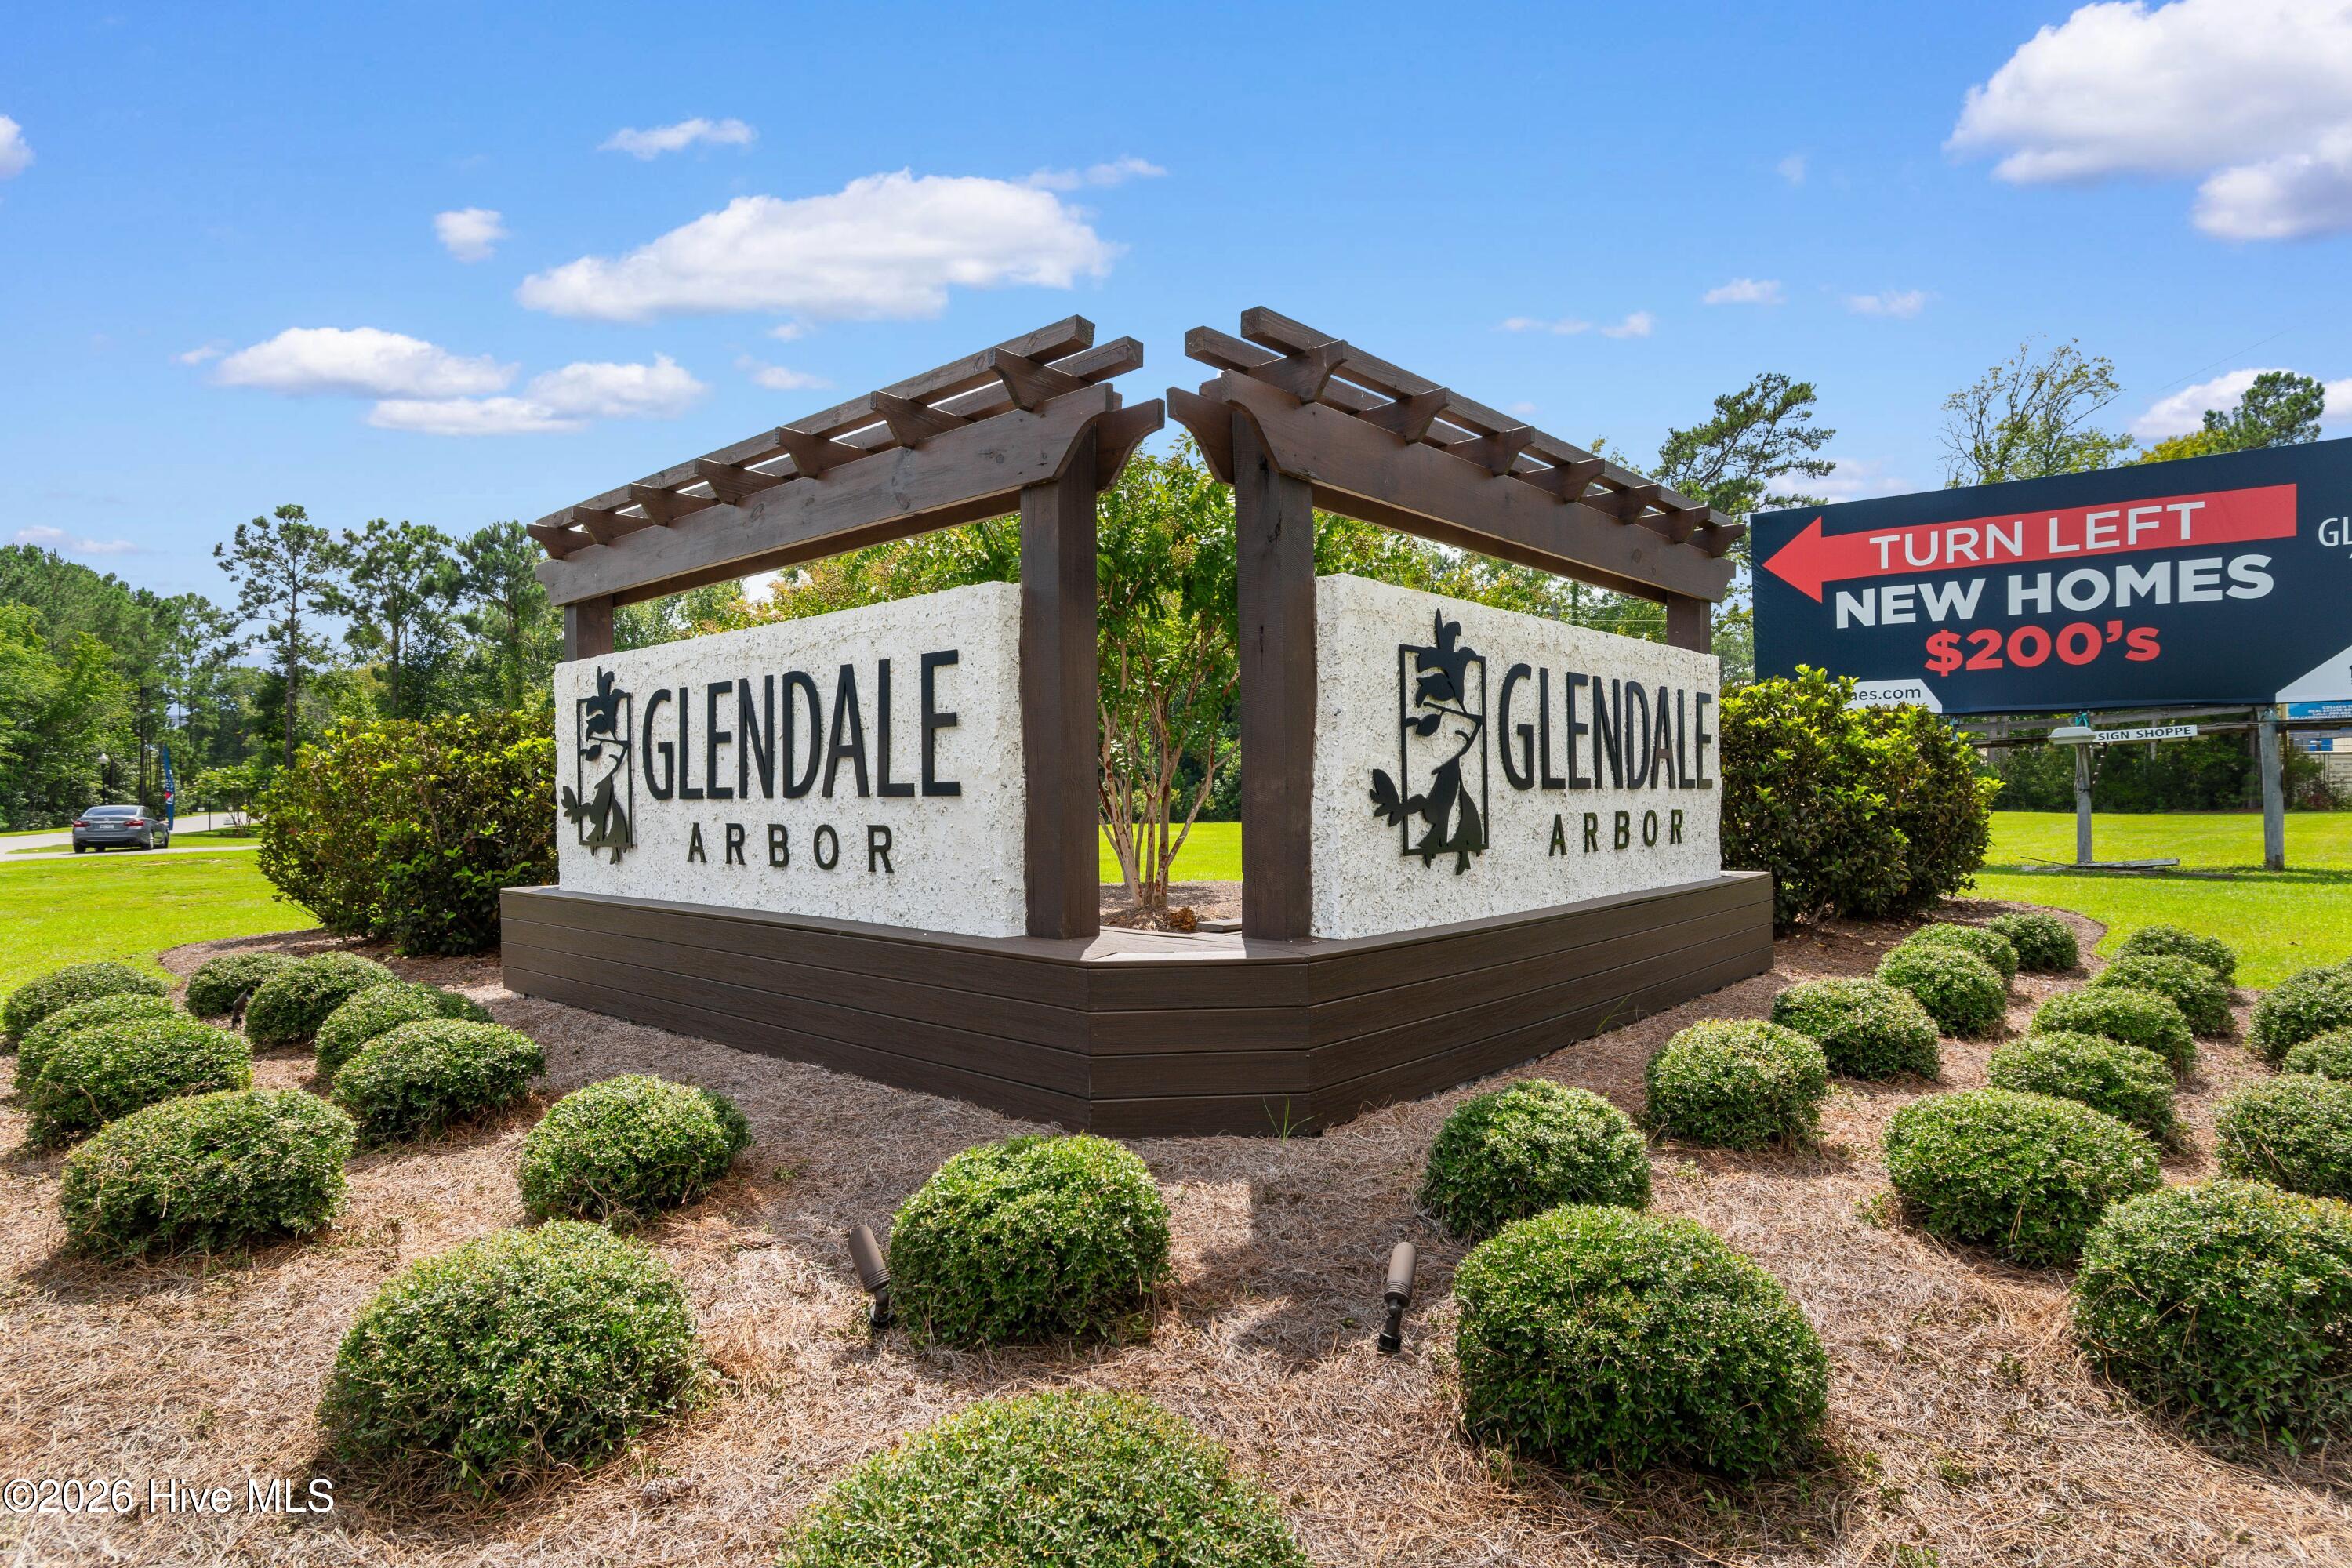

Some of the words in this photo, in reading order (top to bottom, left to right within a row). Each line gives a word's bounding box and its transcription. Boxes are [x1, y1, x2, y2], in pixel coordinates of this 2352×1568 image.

[1869, 521, 2023, 569] TURN
[2049, 501, 2205, 554] LEFT
[1835, 578, 1986, 629] NEW
[2008, 554, 2274, 615] HOMES
[641, 648, 961, 801] GLENDALE
[1499, 662, 1713, 791] GLENDALE
[2098, 731, 2129, 741] SIGN
[2136, 726, 2192, 739] SHOPPE
[688, 822, 894, 873] ARBOR
[1549, 809, 1684, 857] ARBOR
